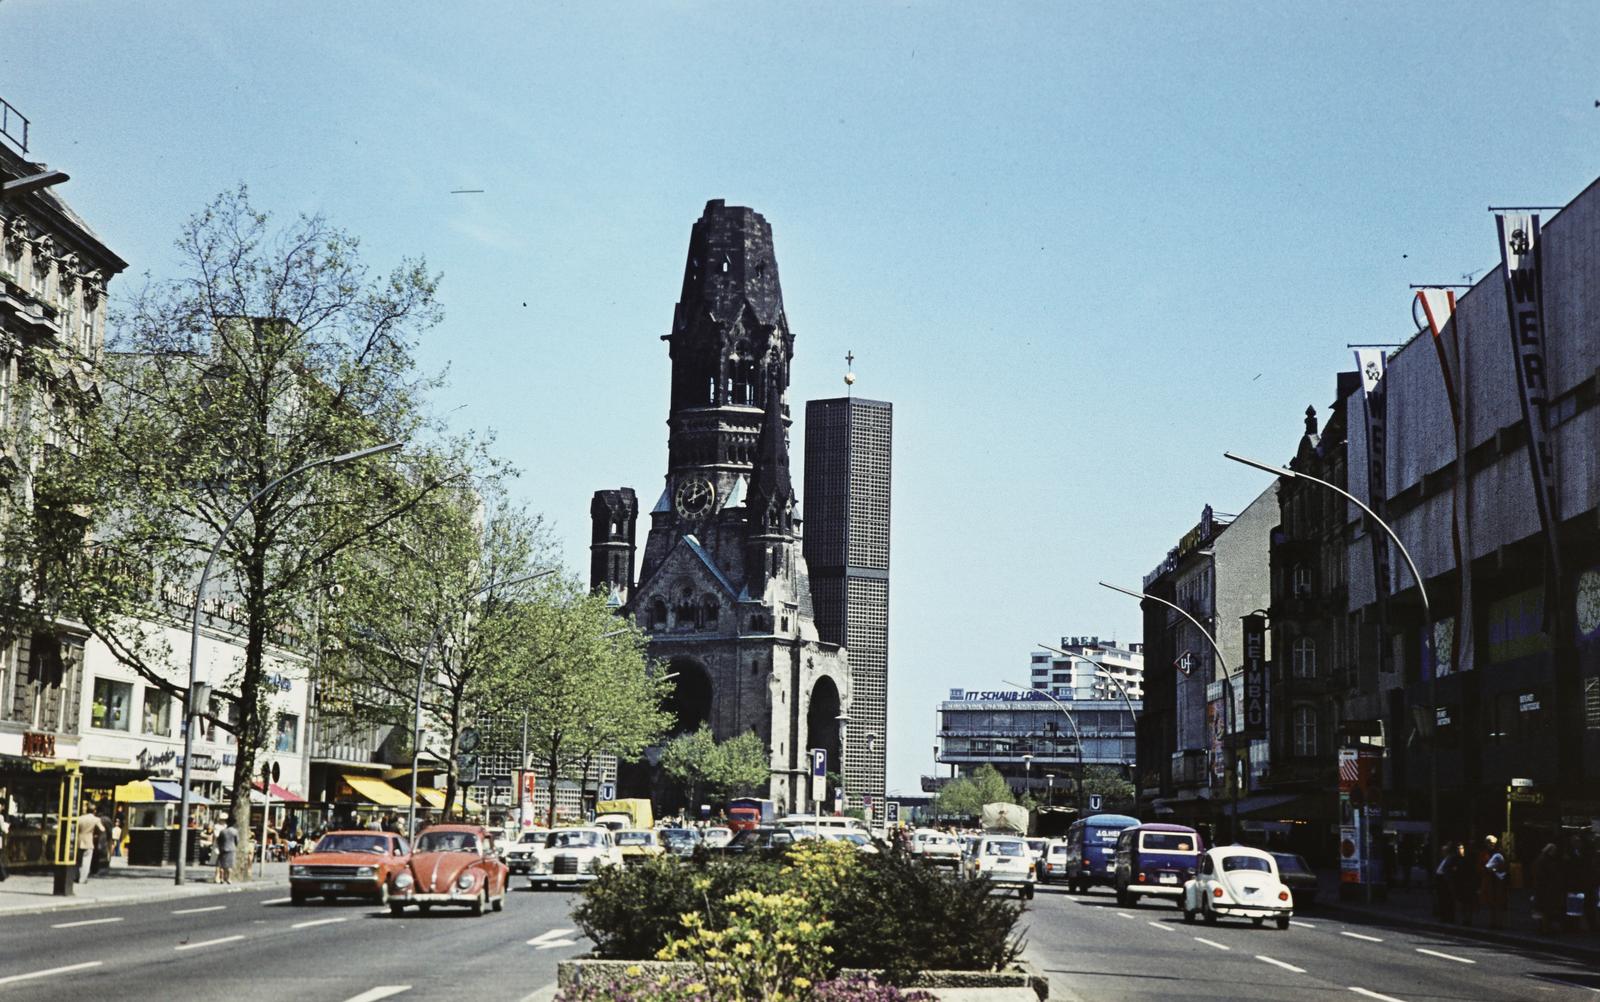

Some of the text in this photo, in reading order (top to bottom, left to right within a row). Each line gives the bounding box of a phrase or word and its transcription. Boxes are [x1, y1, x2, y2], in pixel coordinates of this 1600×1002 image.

[1248, 632, 1262, 725] HEIMBAU
[965, 691, 980, 701] ITT
[815, 752, 825, 769] P
[604, 787, 613, 800] U
[1091, 797, 1100, 810] U
